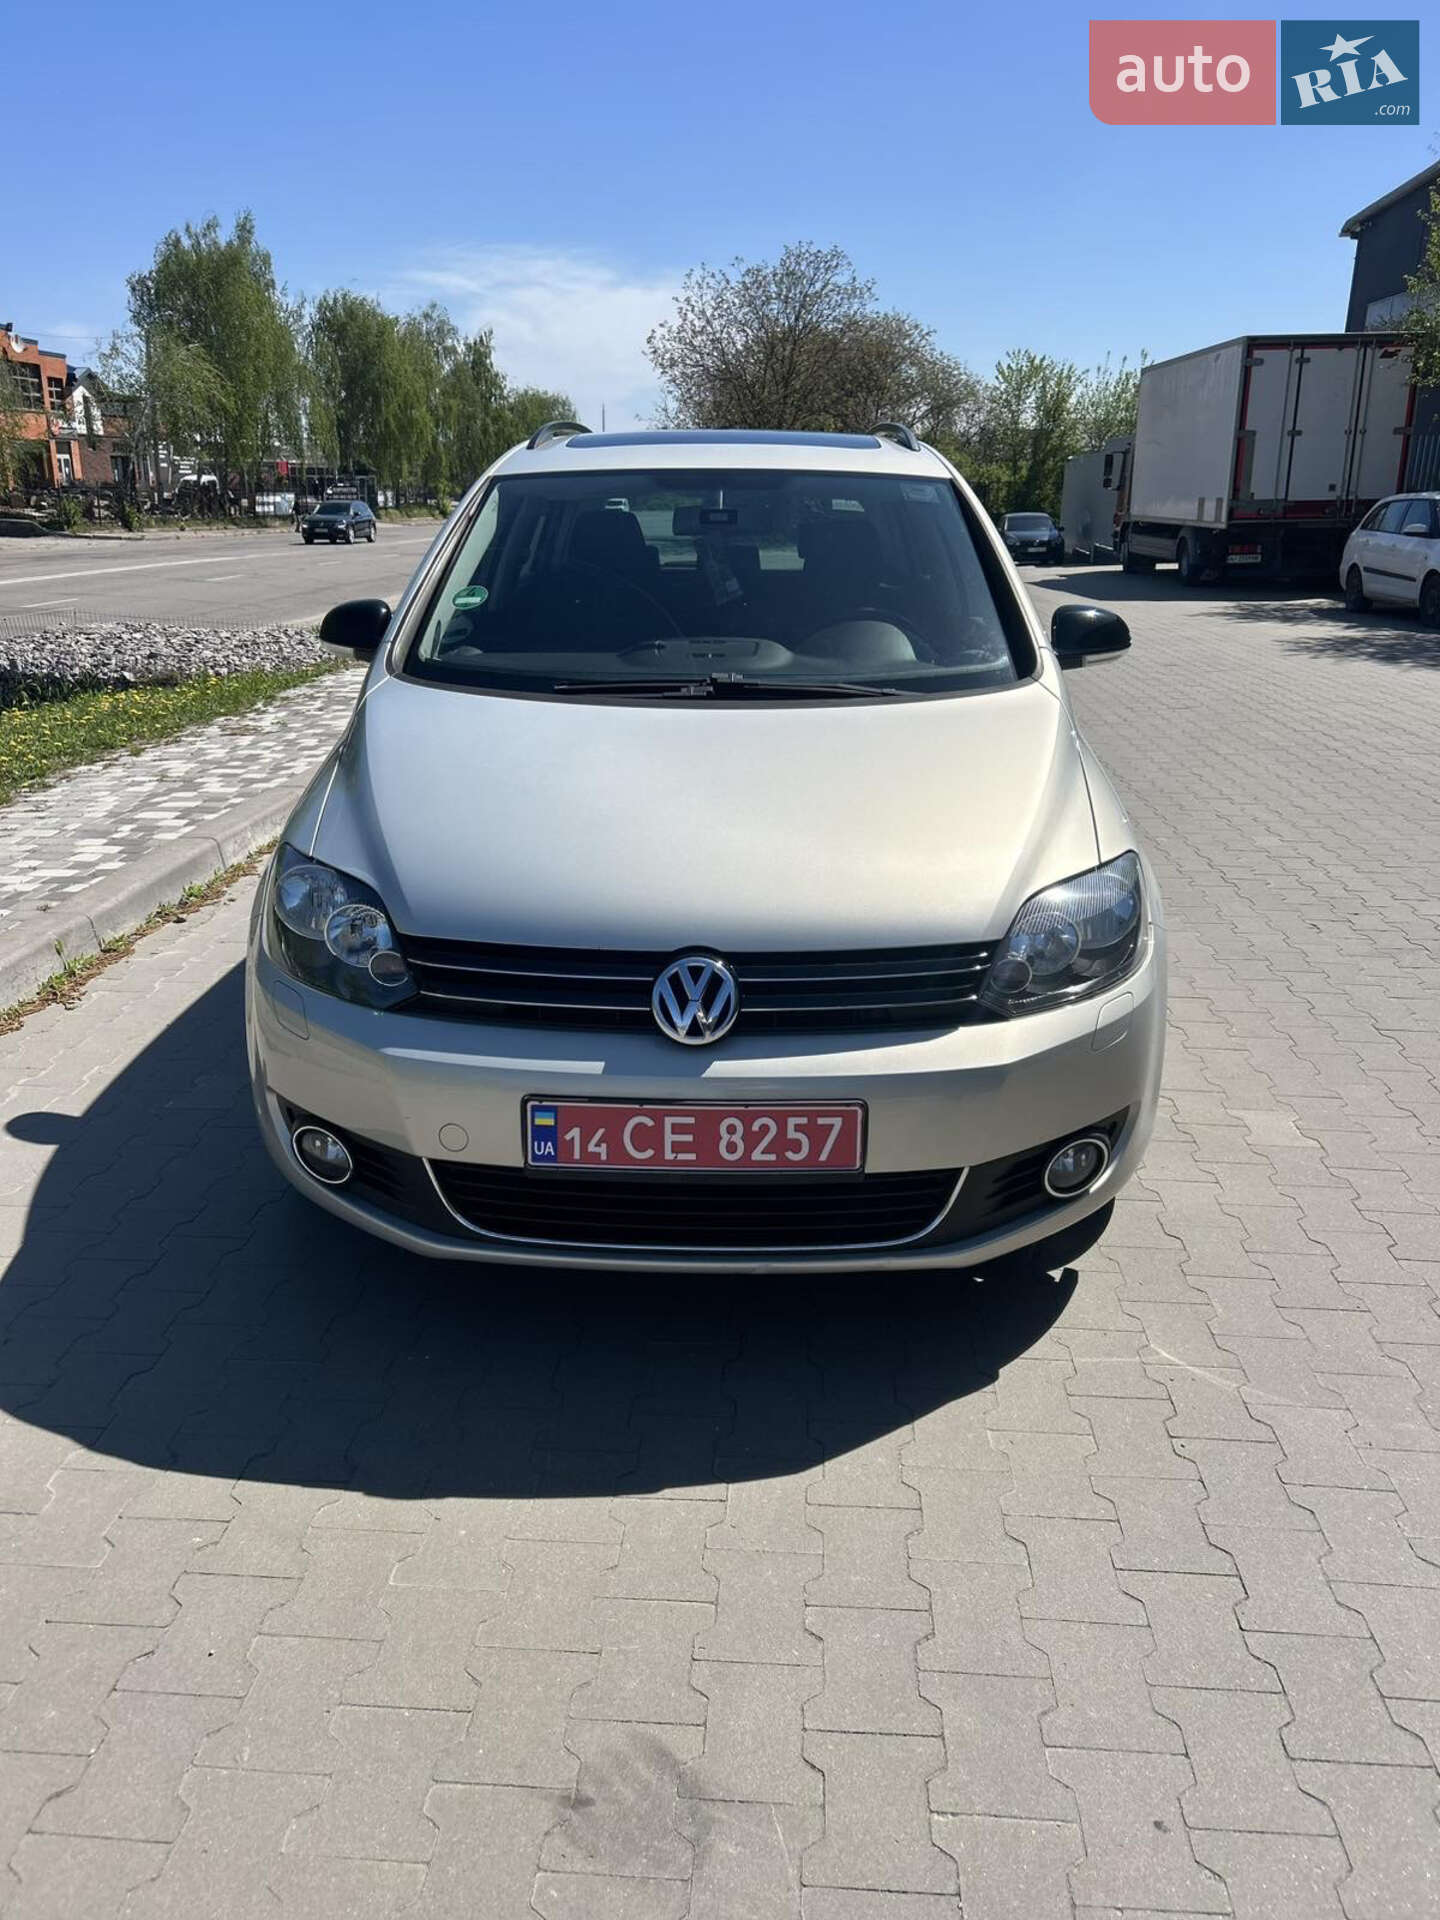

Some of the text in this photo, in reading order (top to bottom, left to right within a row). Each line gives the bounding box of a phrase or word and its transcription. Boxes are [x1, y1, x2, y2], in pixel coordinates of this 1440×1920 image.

[533, 1140, 555, 1157] UA
[563, 1116, 844, 1162] 14 CE 8257
